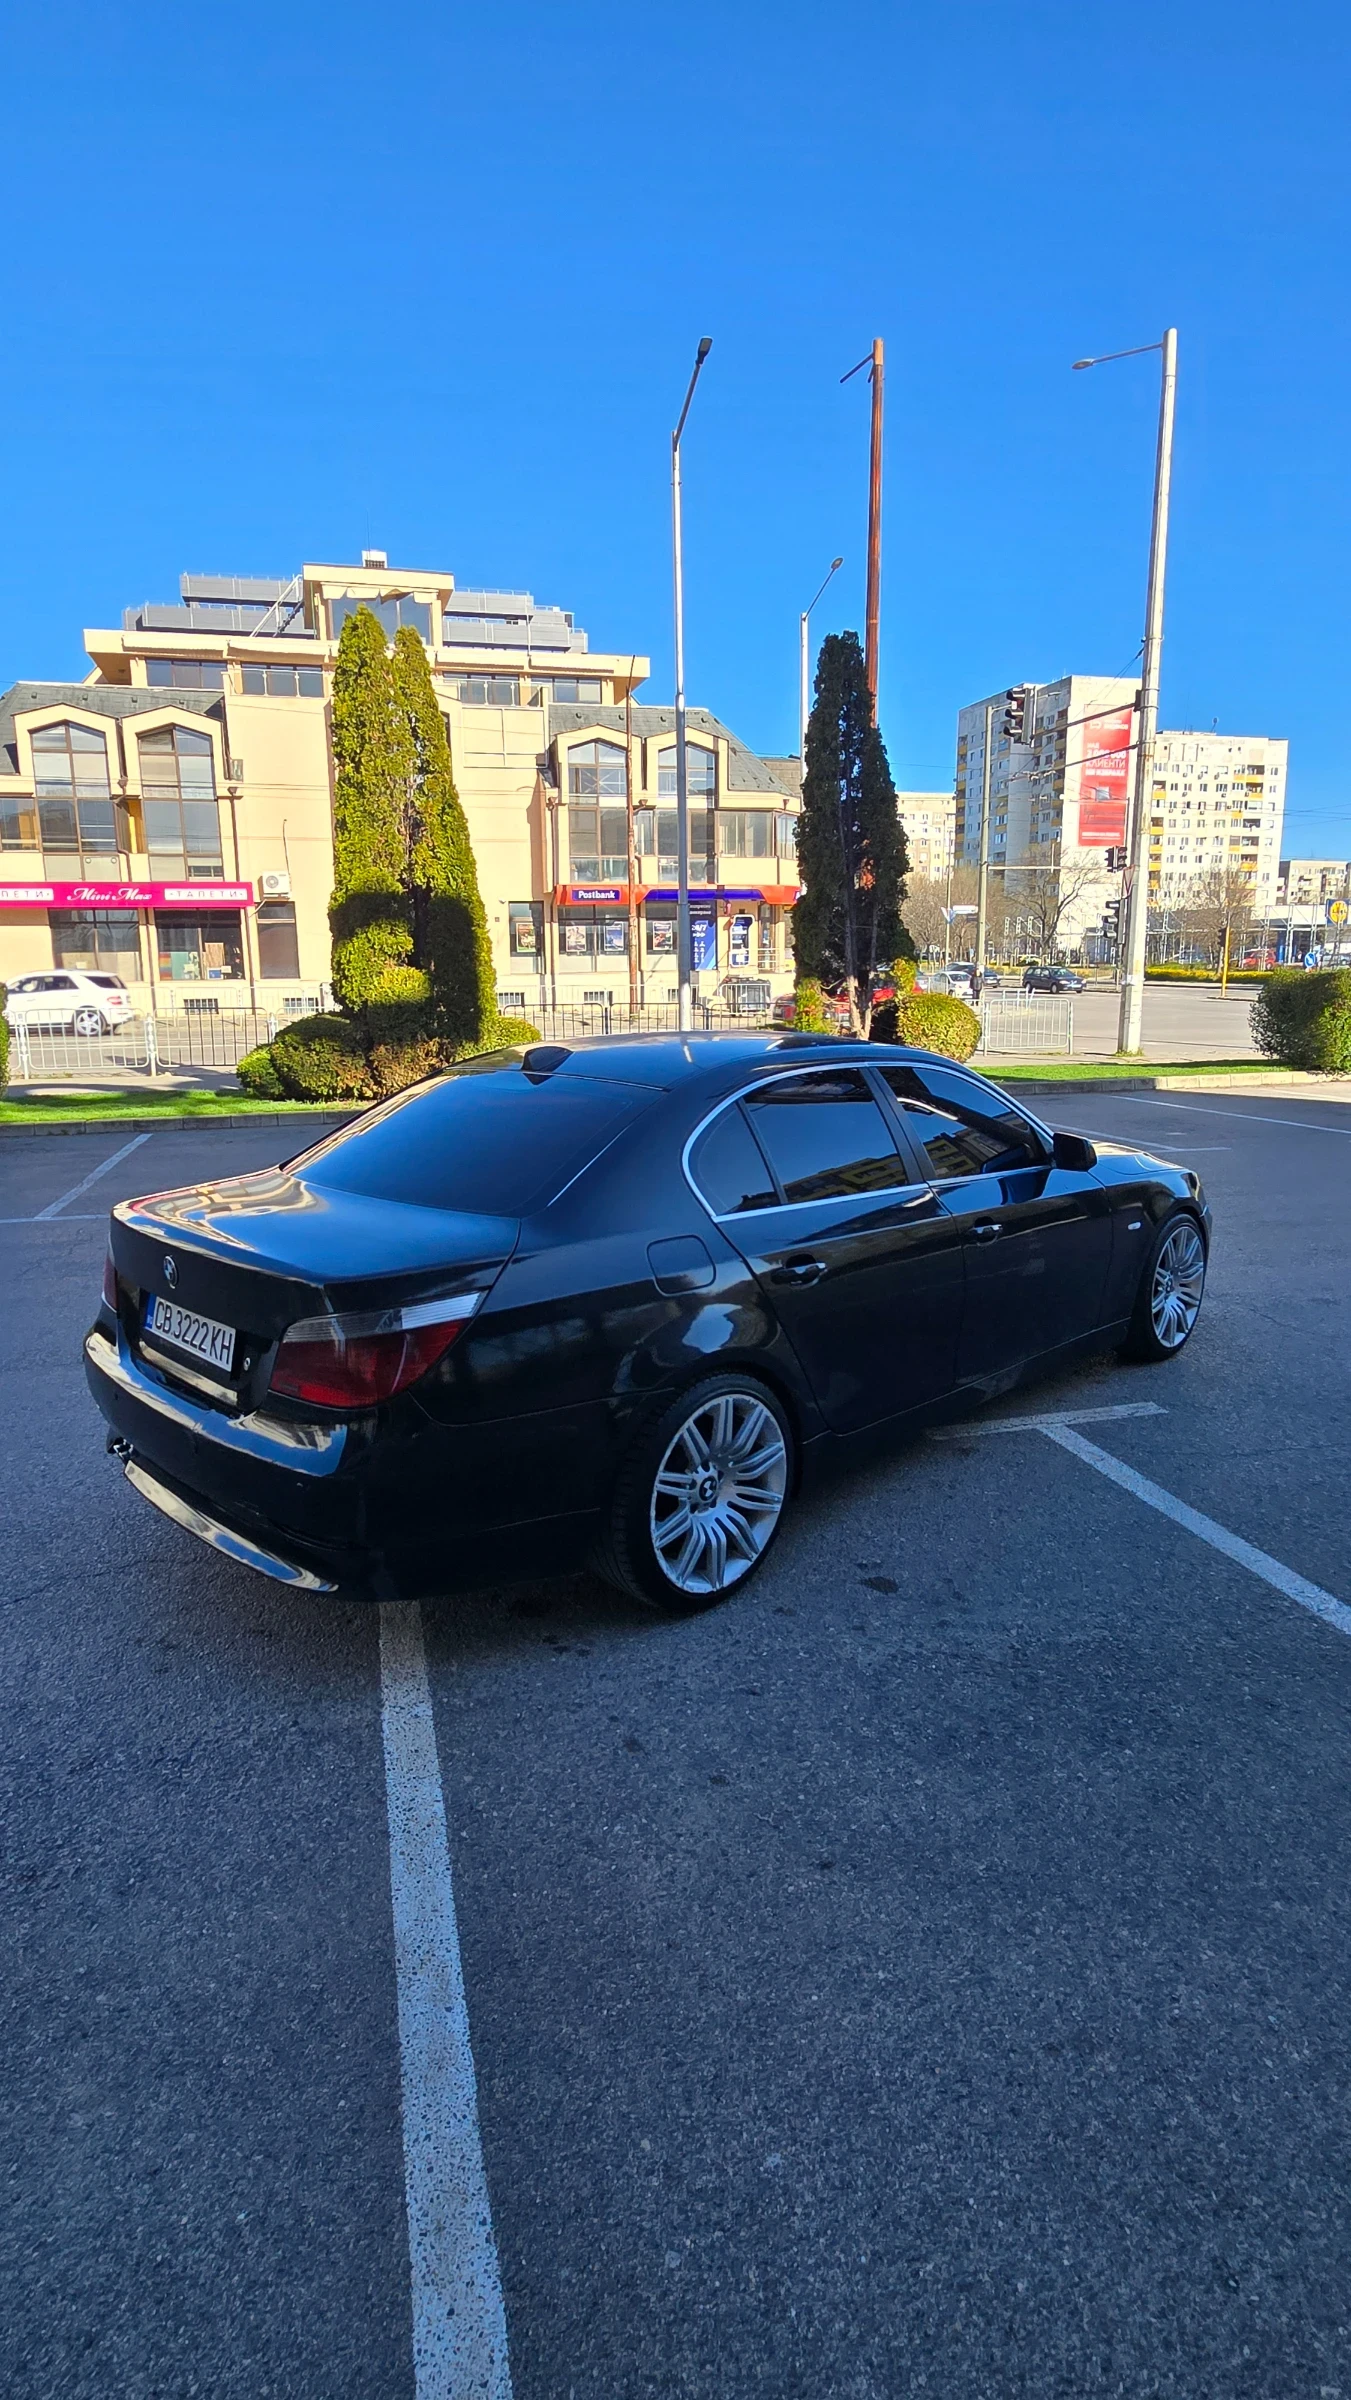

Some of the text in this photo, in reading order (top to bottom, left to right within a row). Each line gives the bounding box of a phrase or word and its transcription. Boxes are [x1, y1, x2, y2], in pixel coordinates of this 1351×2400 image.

[1085, 758, 1126, 769] КЛИЕНТИ
[67, 888, 152, 900] Mini Max
[177, 890, 238, 898] ТАПЕТИ
[578, 891, 615, 899] Postbank
